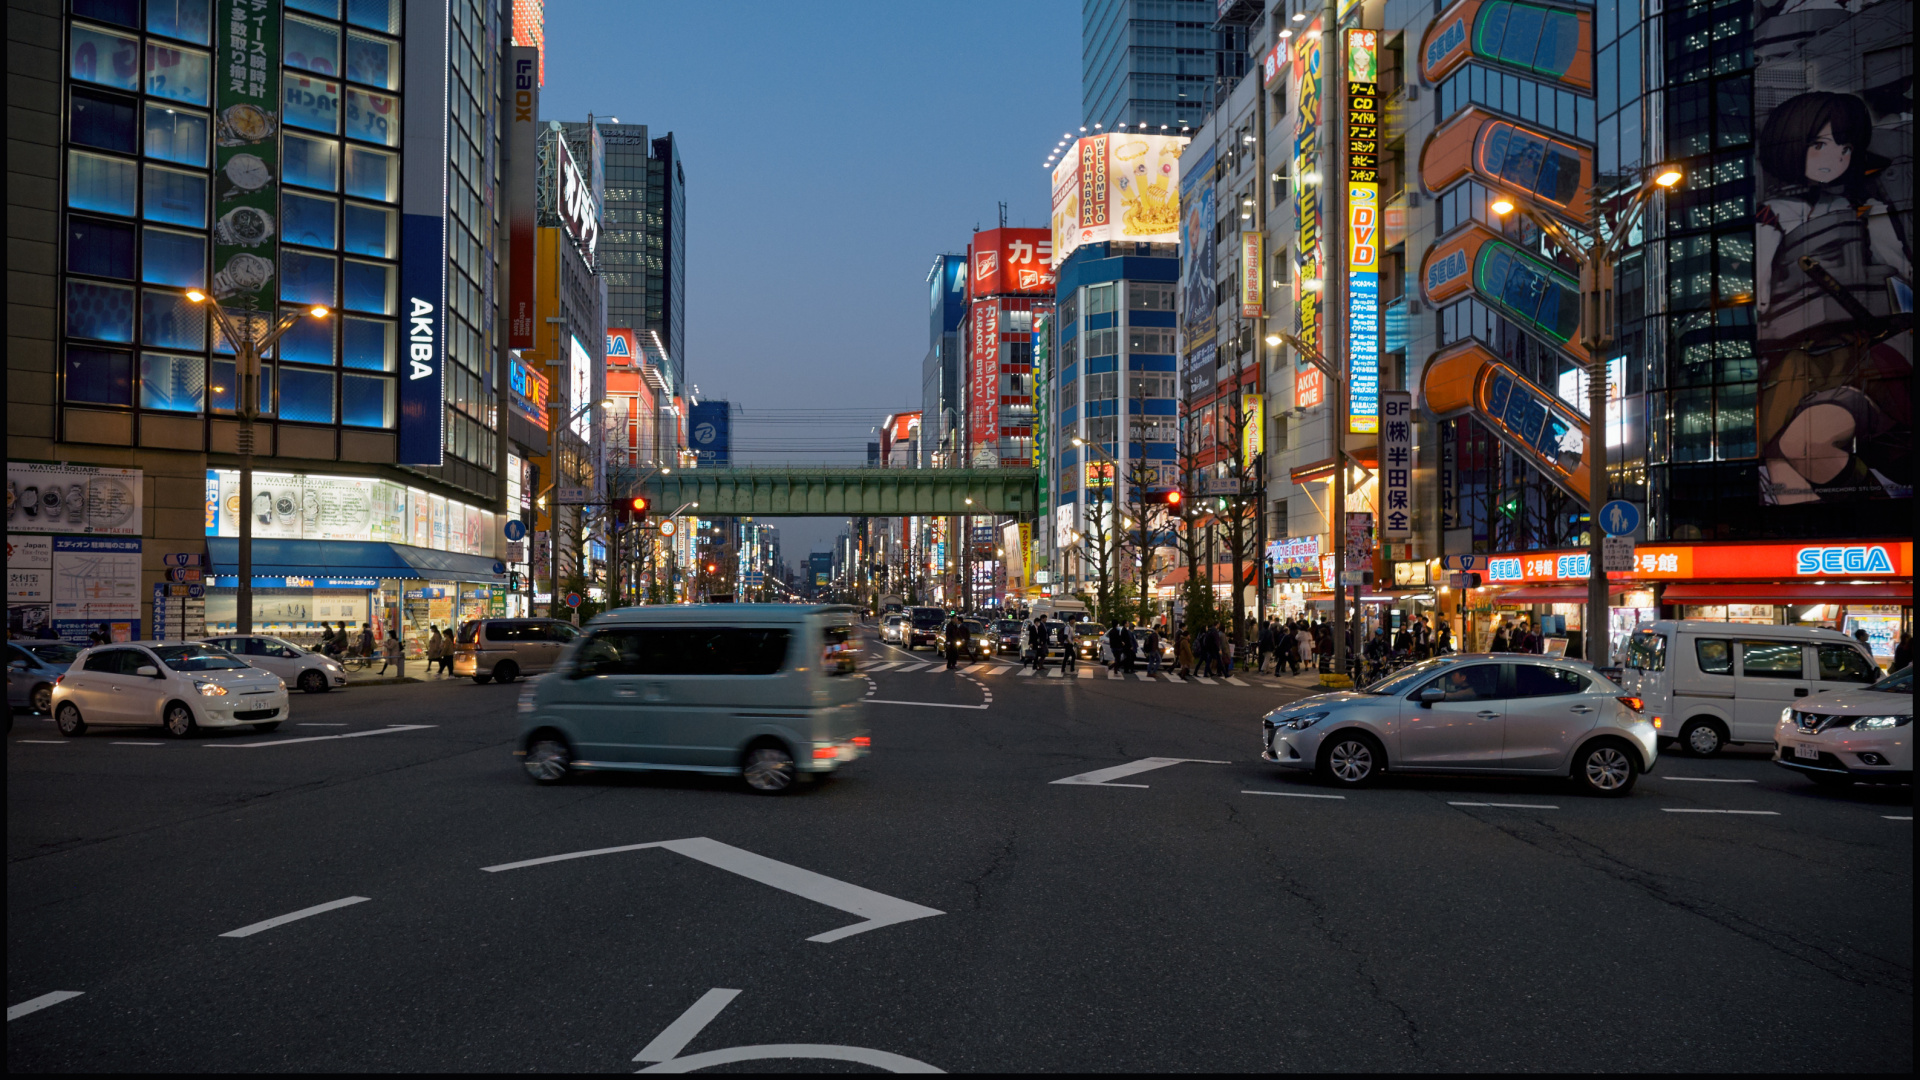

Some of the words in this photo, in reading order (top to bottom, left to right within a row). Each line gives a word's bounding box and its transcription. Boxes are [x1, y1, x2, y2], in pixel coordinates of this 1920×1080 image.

[1350, 32, 1375, 47] 激安
[1427, 18, 1466, 71] SEGA
[1300, 38, 1316, 133] TAX
[1351, 83, 1376, 96] ゲーム
[1353, 99, 1373, 110] CD
[1350, 112, 1376, 124] アイドル
[1350, 127, 1376, 138] アニメ
[1350, 141, 1375, 153] コミック
[1096, 139, 1105, 200] WELCOME
[1352, 156, 1375, 167] ホビー
[1350, 169, 1376, 182] フィギュア
[1084, 146, 1092, 225] AKIHABARA
[1097, 206, 1104, 222] TO
[1352, 207, 1375, 266] DVD
[1428, 248, 1467, 290] SEGA
[409, 297, 433, 380] AKIBA
[985, 305, 996, 360] カラオケ
[1298, 370, 1320, 391] AKKY
[985, 374, 995, 435] アドアーズ
[1300, 388, 1317, 406] ONE
[1386, 402, 1409, 416] 8F
[1386, 421, 1410, 532] (株)半田保全
[663, 524, 673, 532] 50
[57, 541, 90, 549] エディオン
[179, 555, 187, 563] 17
[1462, 557, 1473, 567] 17
[1796, 546, 1897, 574] SEGA
[178, 570, 185, 578] 17
[1490, 559, 1523, 580] SEGA
[1527, 560, 1553, 576] 2号館
[190, 586, 200, 595] 437
